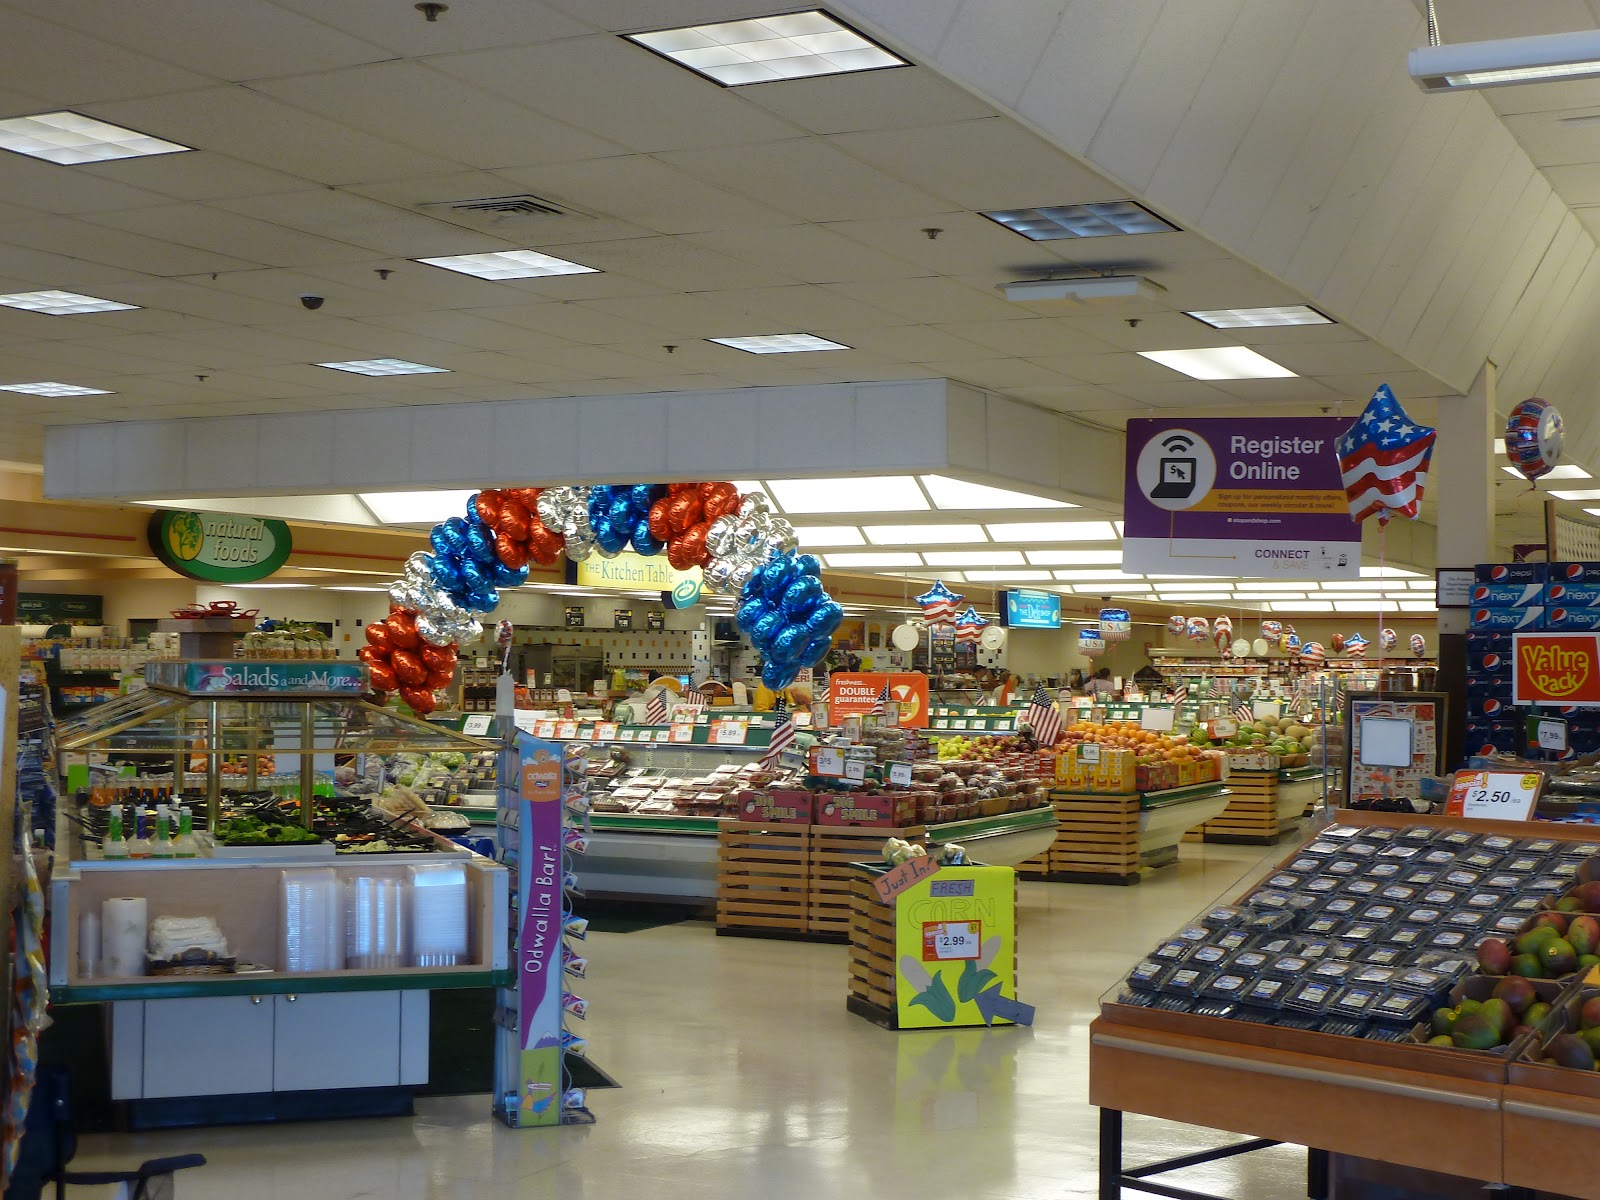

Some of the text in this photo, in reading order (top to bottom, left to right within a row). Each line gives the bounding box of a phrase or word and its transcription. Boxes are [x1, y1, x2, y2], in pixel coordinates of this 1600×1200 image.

[1230, 435, 1324, 459] Register
[1229, 461, 1301, 481] Online
[1218, 493, 1229, 502] Sign
[1230, 494, 1242, 502] up
[1254, 493, 1294, 502] personalized
[1295, 494, 1322, 503] monthly
[1217, 502, 1247, 510] coupons,
[1261, 501, 1283, 510] weekly
[206, 519, 264, 541] natural
[213, 540, 259, 564] foods
[1254, 548, 1310, 559] CONNECT
[1272, 559, 1310, 570] & SAVE
[585, 560, 674, 584] THE Kitchen Table
[1510, 569, 1532, 578] pepsi
[1020, 608, 1028, 616] THE
[1028, 604, 1041, 619] Deli
[1100, 622, 1123, 631] USA
[1085, 639, 1104, 648] USA
[1522, 645, 1590, 672] Value
[222, 666, 279, 686] Salads
[1538, 672, 1578, 693] Pack
[840, 687, 876, 696] DOUBLE
[527, 772, 557, 780] odwalla
[754, 795, 775, 807] BIG
[833, 796, 855, 808] BIG
[1471, 790, 1511, 803] $2.50
[762, 806, 797, 820] SMILE
[841, 808, 878, 821] SMILE
[881, 856, 936, 896] Just In!
[932, 882, 973, 894] FRESH
[525, 845, 557, 973] Odwalla Bar!
[907, 898, 996, 930] CORN
[939, 936, 965, 946] $2.99
